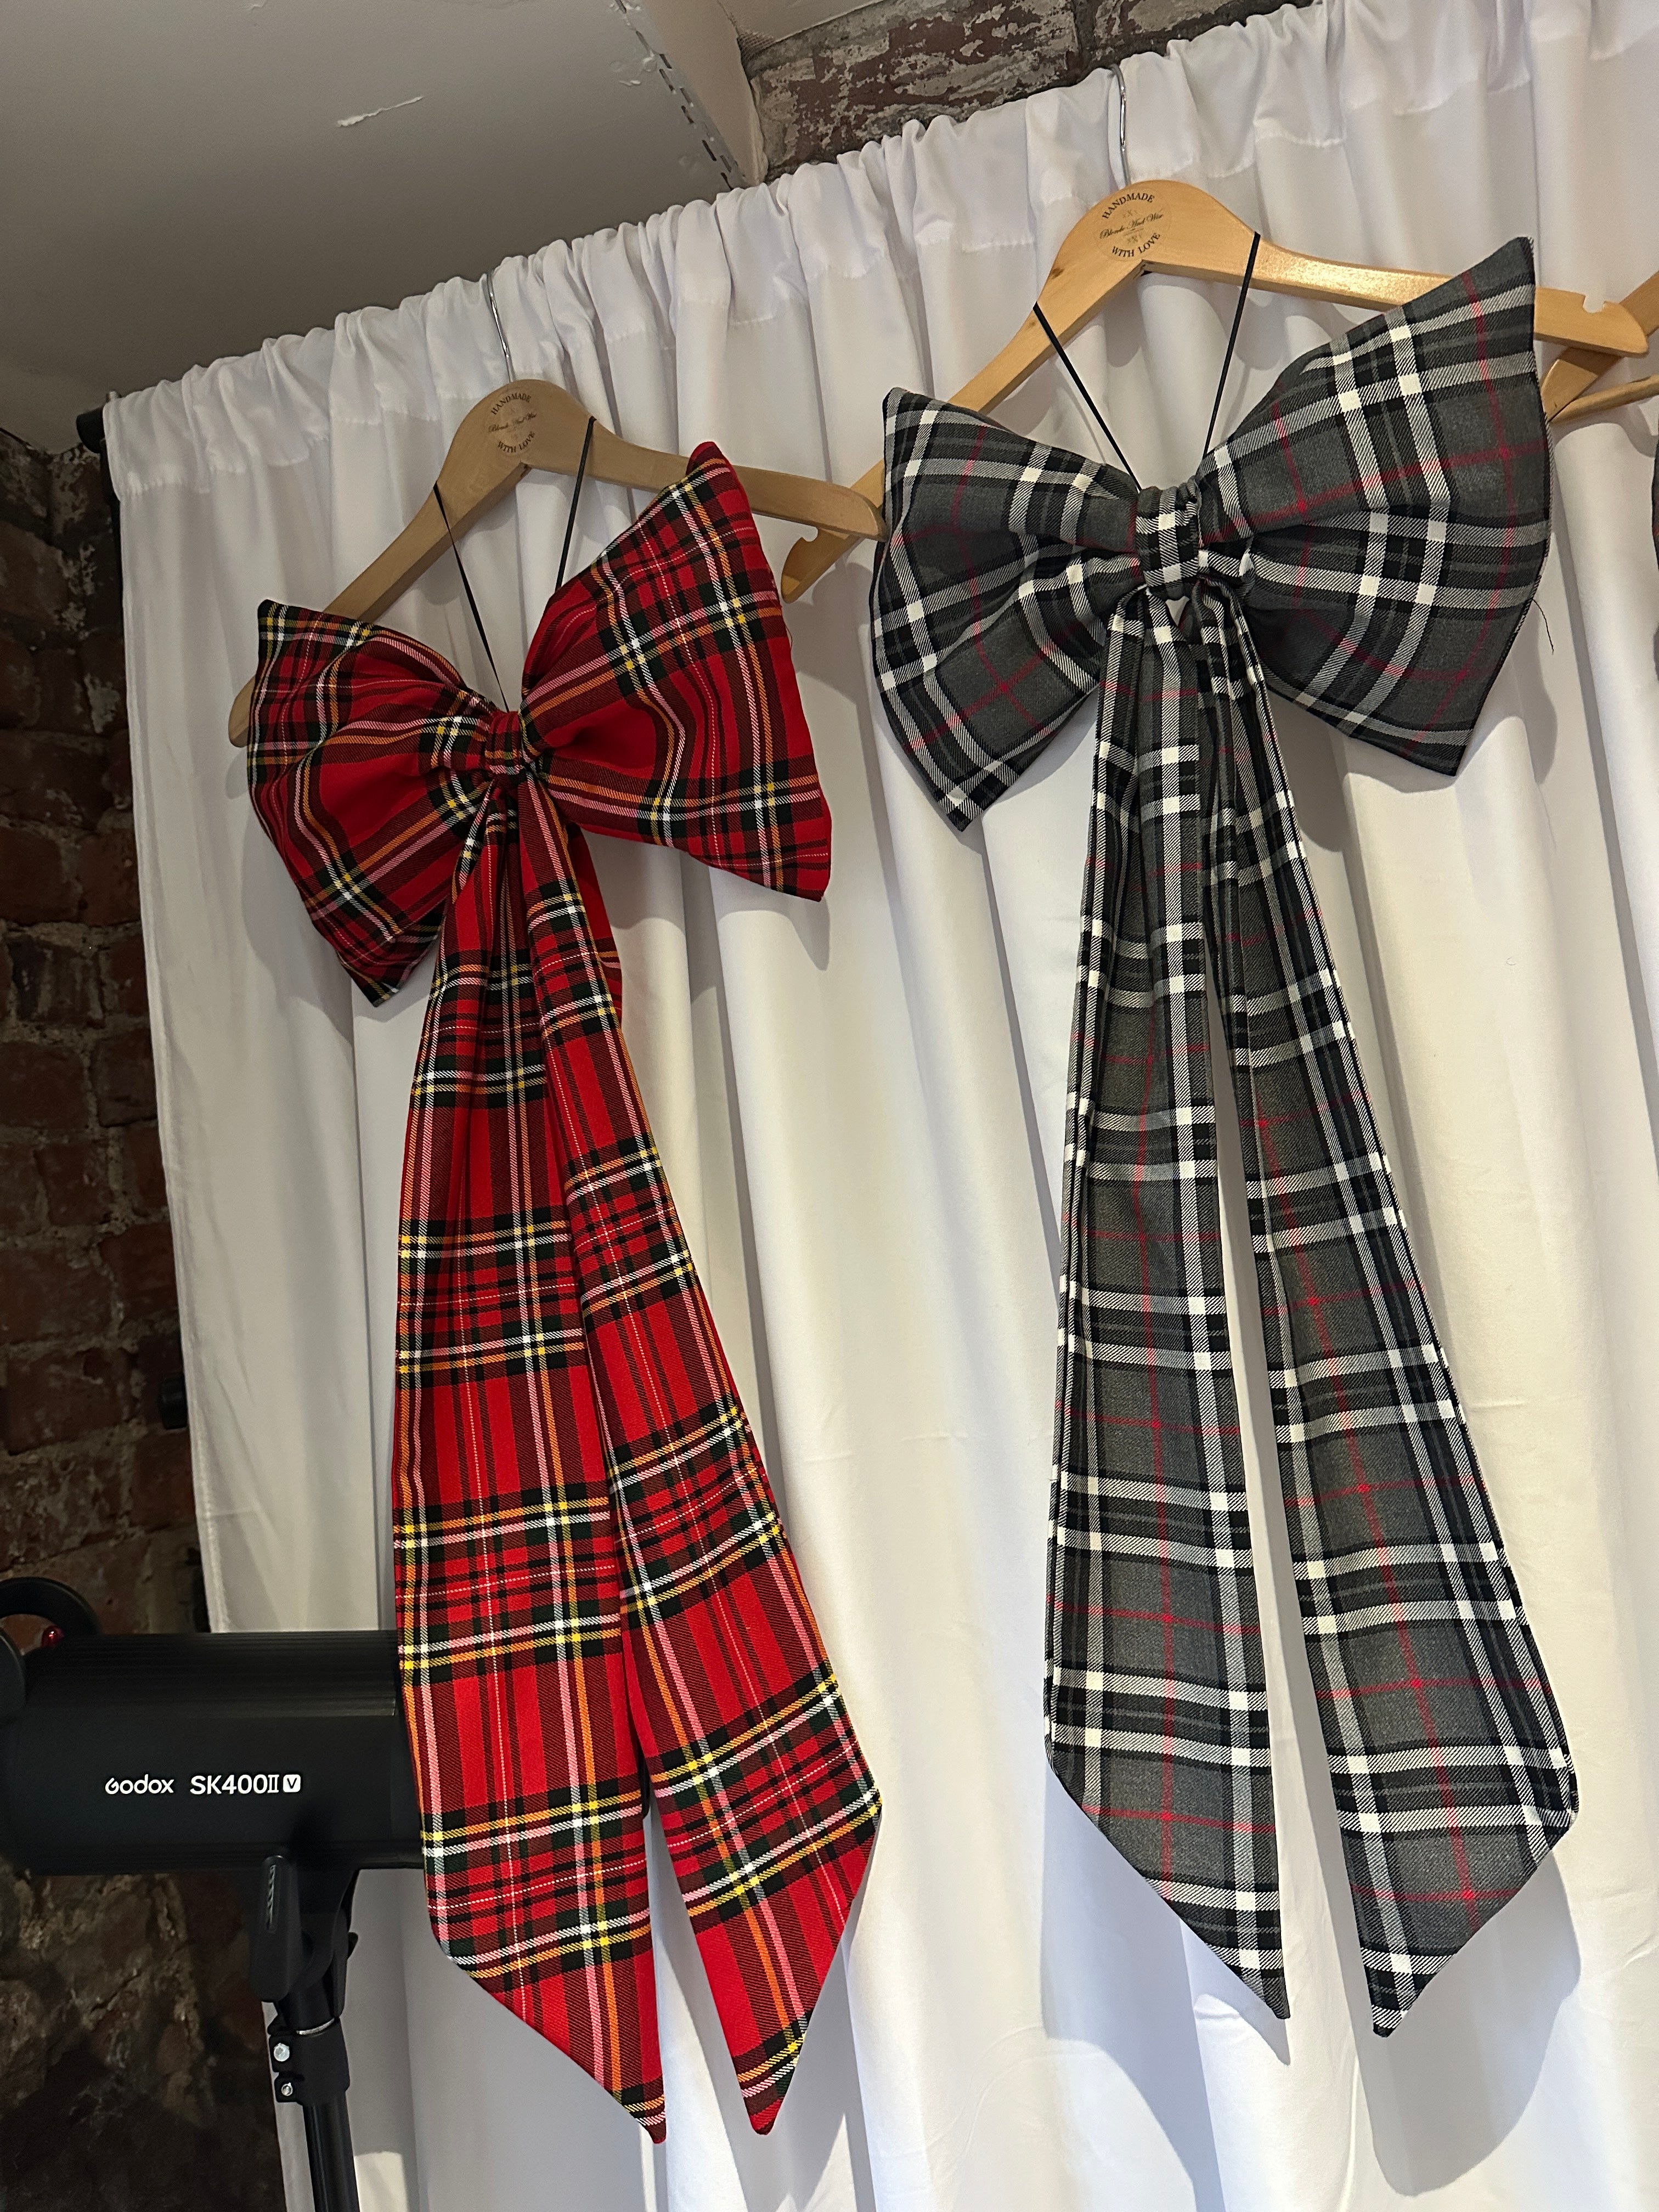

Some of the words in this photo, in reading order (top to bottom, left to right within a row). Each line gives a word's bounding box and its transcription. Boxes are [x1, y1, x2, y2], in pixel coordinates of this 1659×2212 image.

[1102, 193, 1155, 219] HANDMADE
[1111, 246, 1135, 257] WITH
[1138, 233, 1160, 253] LOVE
[491, 393, 532, 415] HANDMADE
[497, 441, 516, 453] WITH
[518, 431, 535, 450] LOVE
[105, 1774, 174, 1795] Godox
